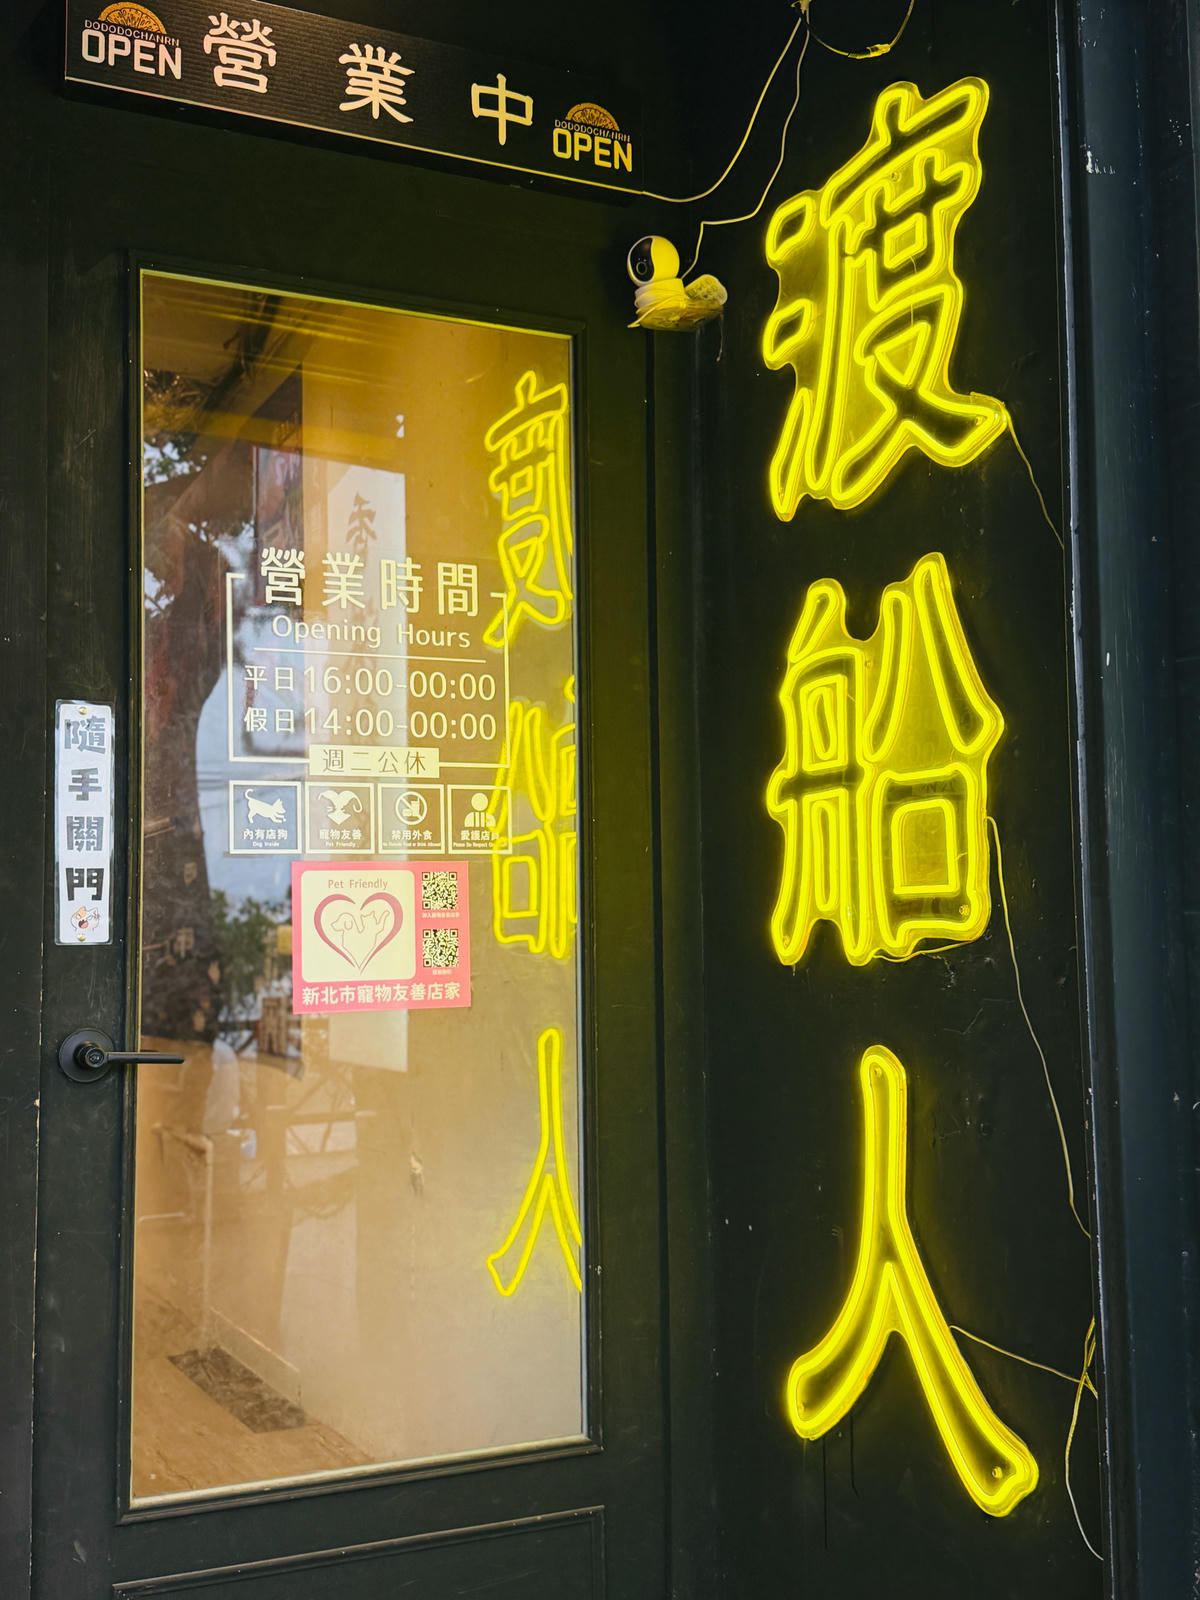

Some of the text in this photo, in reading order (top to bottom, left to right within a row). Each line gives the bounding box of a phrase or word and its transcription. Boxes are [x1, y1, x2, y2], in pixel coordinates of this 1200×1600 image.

[85, 19, 180, 47] DODODOCHANRN
[82, 28, 182, 80] OPEN
[203, 12, 534, 146] 營業中
[552, 127, 633, 173] OPEN
[260, 547, 479, 617] 營業時間
[272, 614, 471, 649] Opening Hours
[243, 665, 496, 702] 平日 16:00-00:00
[243, 706, 497, 740] 假日 14:00-00:00
[322, 748, 427, 775] 週二公休
[64, 715, 106, 902] 隨手關門
[763, 76, 1039, 1517] 渡船人
[319, 828, 362, 840] 寵物友善
[391, 829, 433, 841] 禁用外食
[328, 878, 388, 891] Pet Friendly
[302, 982, 461, 1005] 新北市寵物友善店家
